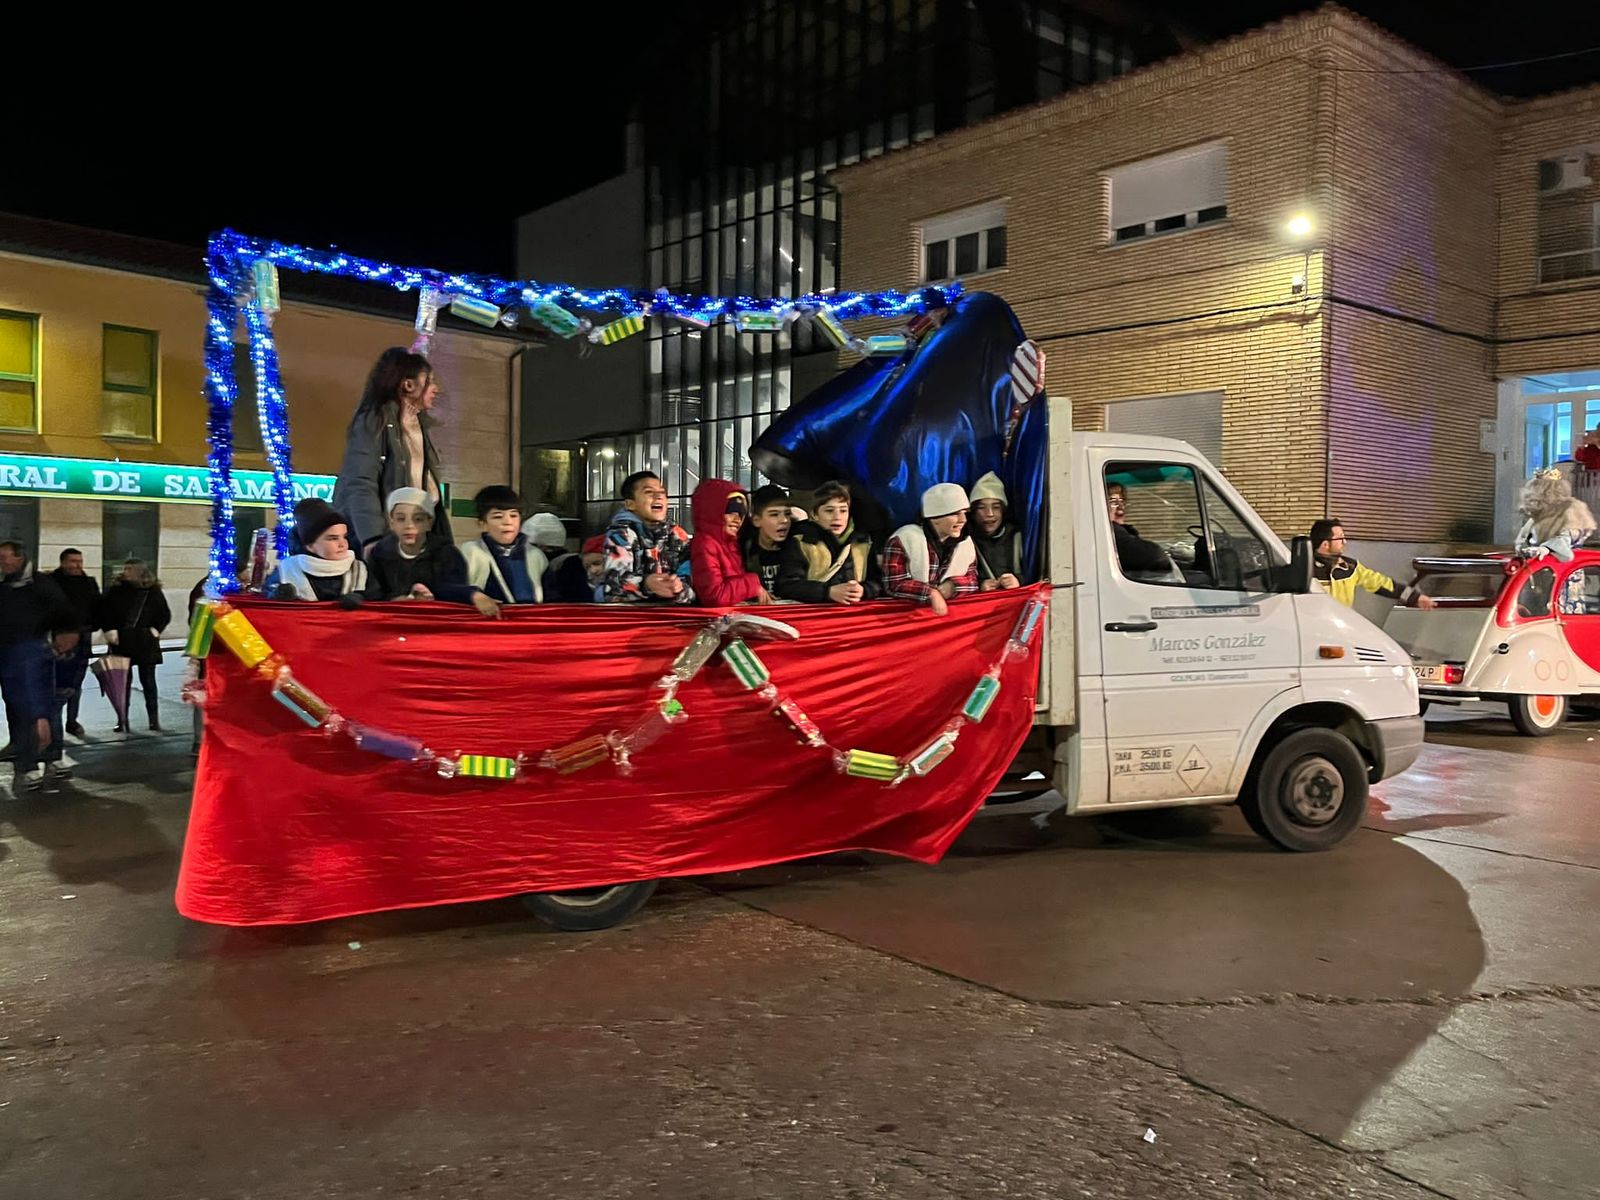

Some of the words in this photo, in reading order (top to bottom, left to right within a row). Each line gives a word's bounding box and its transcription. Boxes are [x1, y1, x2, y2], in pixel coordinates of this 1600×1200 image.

[92, 470, 141, 493] DE
[1149, 637, 1201, 652] Marcos
[1204, 632, 1266, 650] González
[1163, 748, 1173, 759] KG
